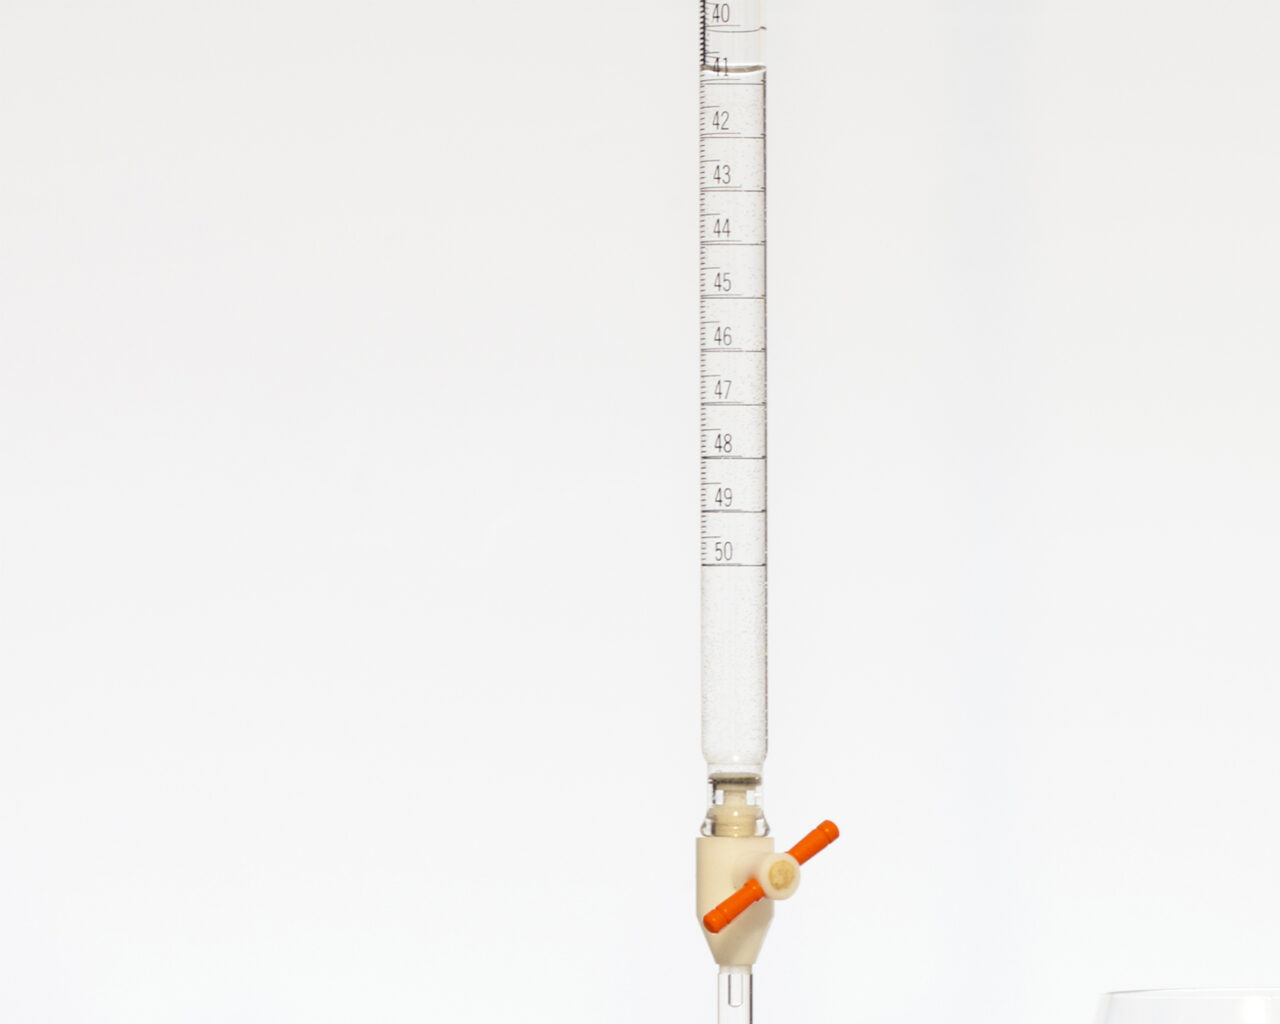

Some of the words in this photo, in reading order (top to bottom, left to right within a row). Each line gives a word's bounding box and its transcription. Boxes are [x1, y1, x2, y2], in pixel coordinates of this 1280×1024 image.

[711, 3, 731, 23] 40
[711, 110, 730, 131] 42
[712, 164, 732, 185] 43
[712, 218, 731, 238] 44
[713, 271, 732, 292] 45
[713, 326, 733, 346] 46
[713, 379, 732, 400] 47
[713, 433, 733, 454] 48
[714, 487, 733, 508] 49
[714, 541, 733, 562] 50
